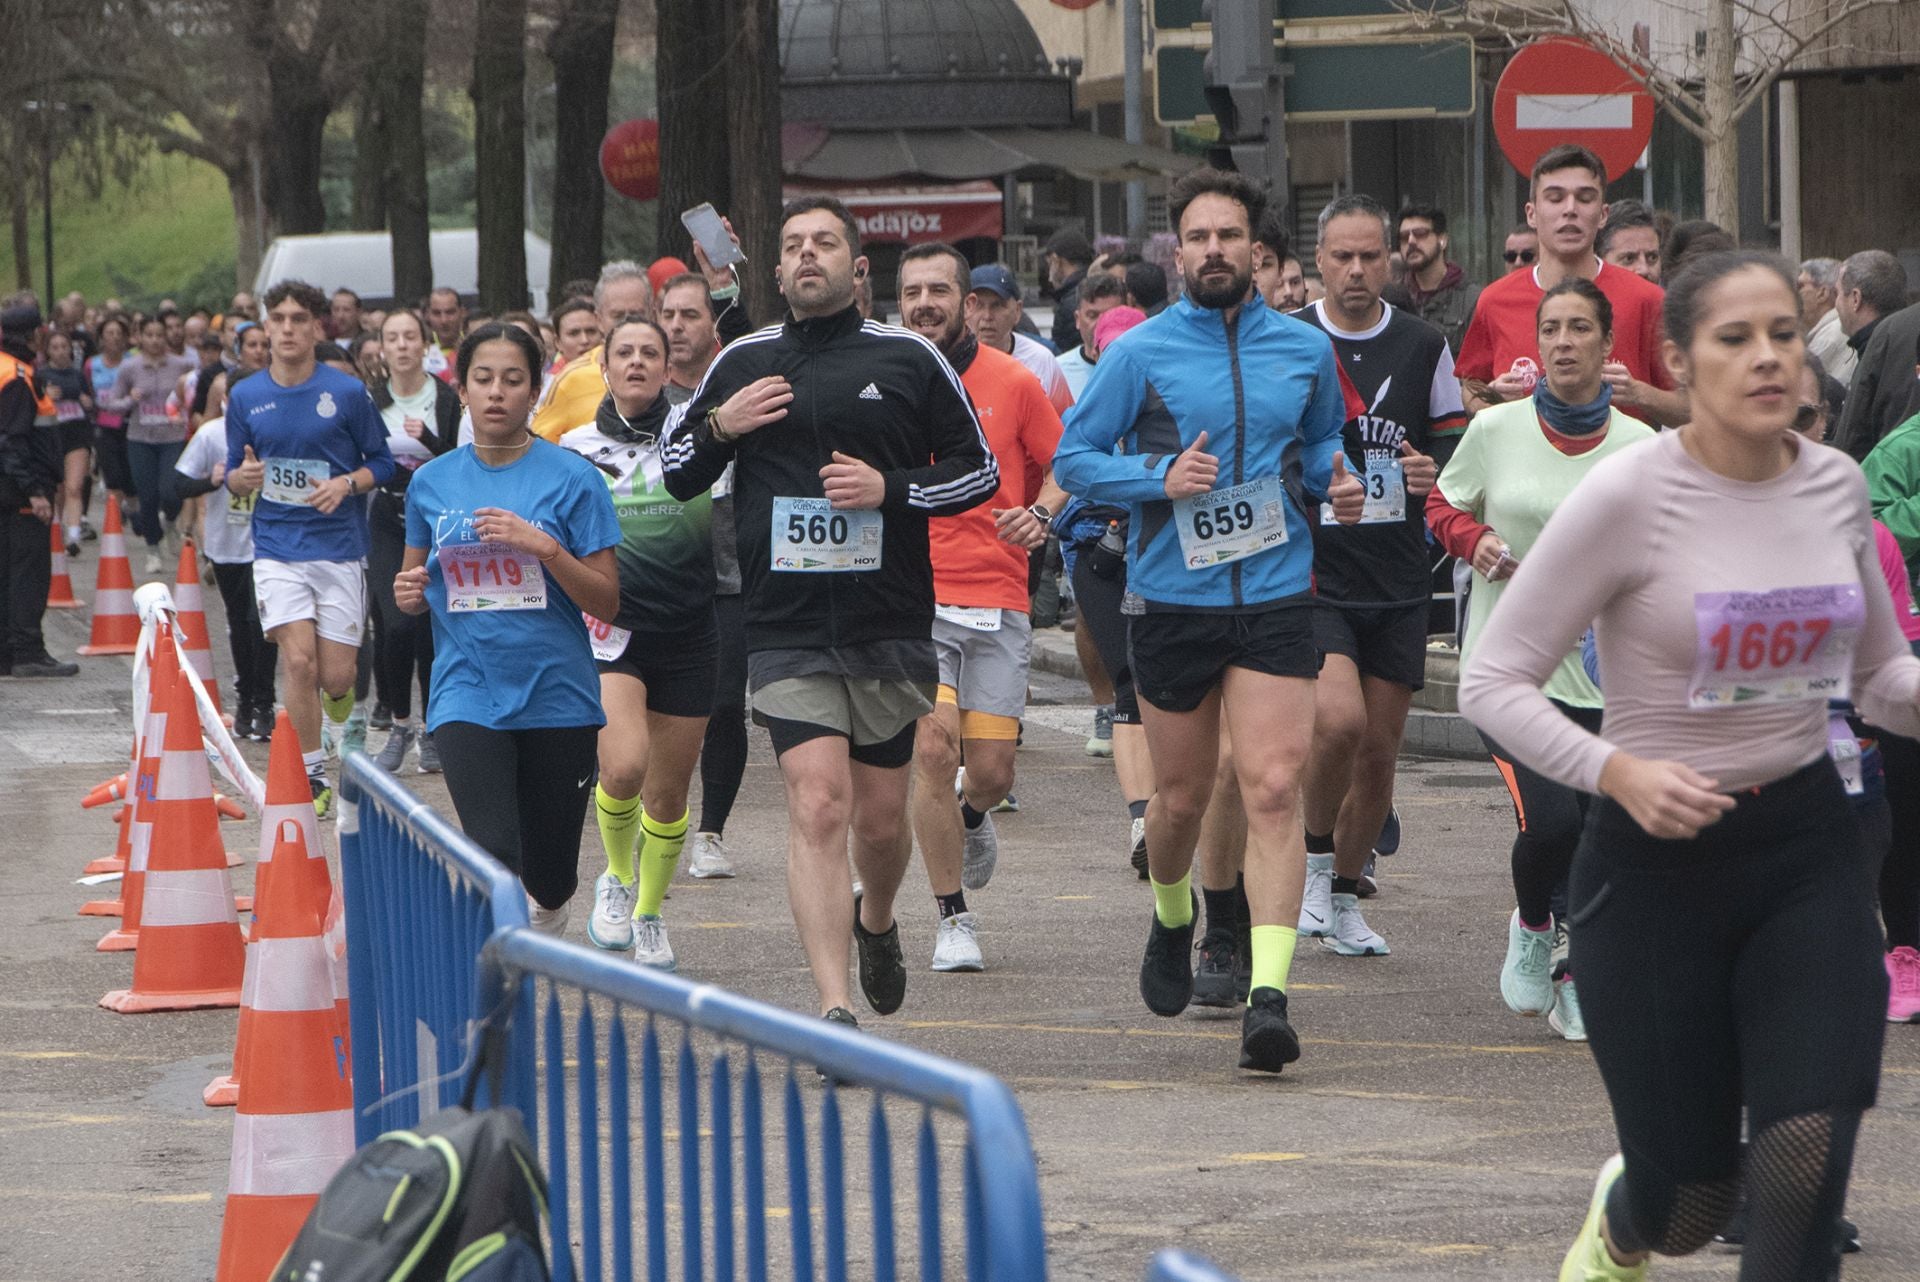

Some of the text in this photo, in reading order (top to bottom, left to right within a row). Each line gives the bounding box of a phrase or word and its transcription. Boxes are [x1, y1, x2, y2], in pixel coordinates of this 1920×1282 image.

[272, 466, 307, 489] 358
[641, 504, 685, 516] JEREZ
[787, 514, 848, 545] 560
[1193, 501, 1254, 540] 659
[1263, 531, 1283, 544] HOY
[854, 557, 877, 565] HOY
[448, 558, 522, 588] 1719
[523, 595, 543, 604] HOY
[1710, 618, 1832, 672] 1667
[1807, 677, 1840, 690] HOY
